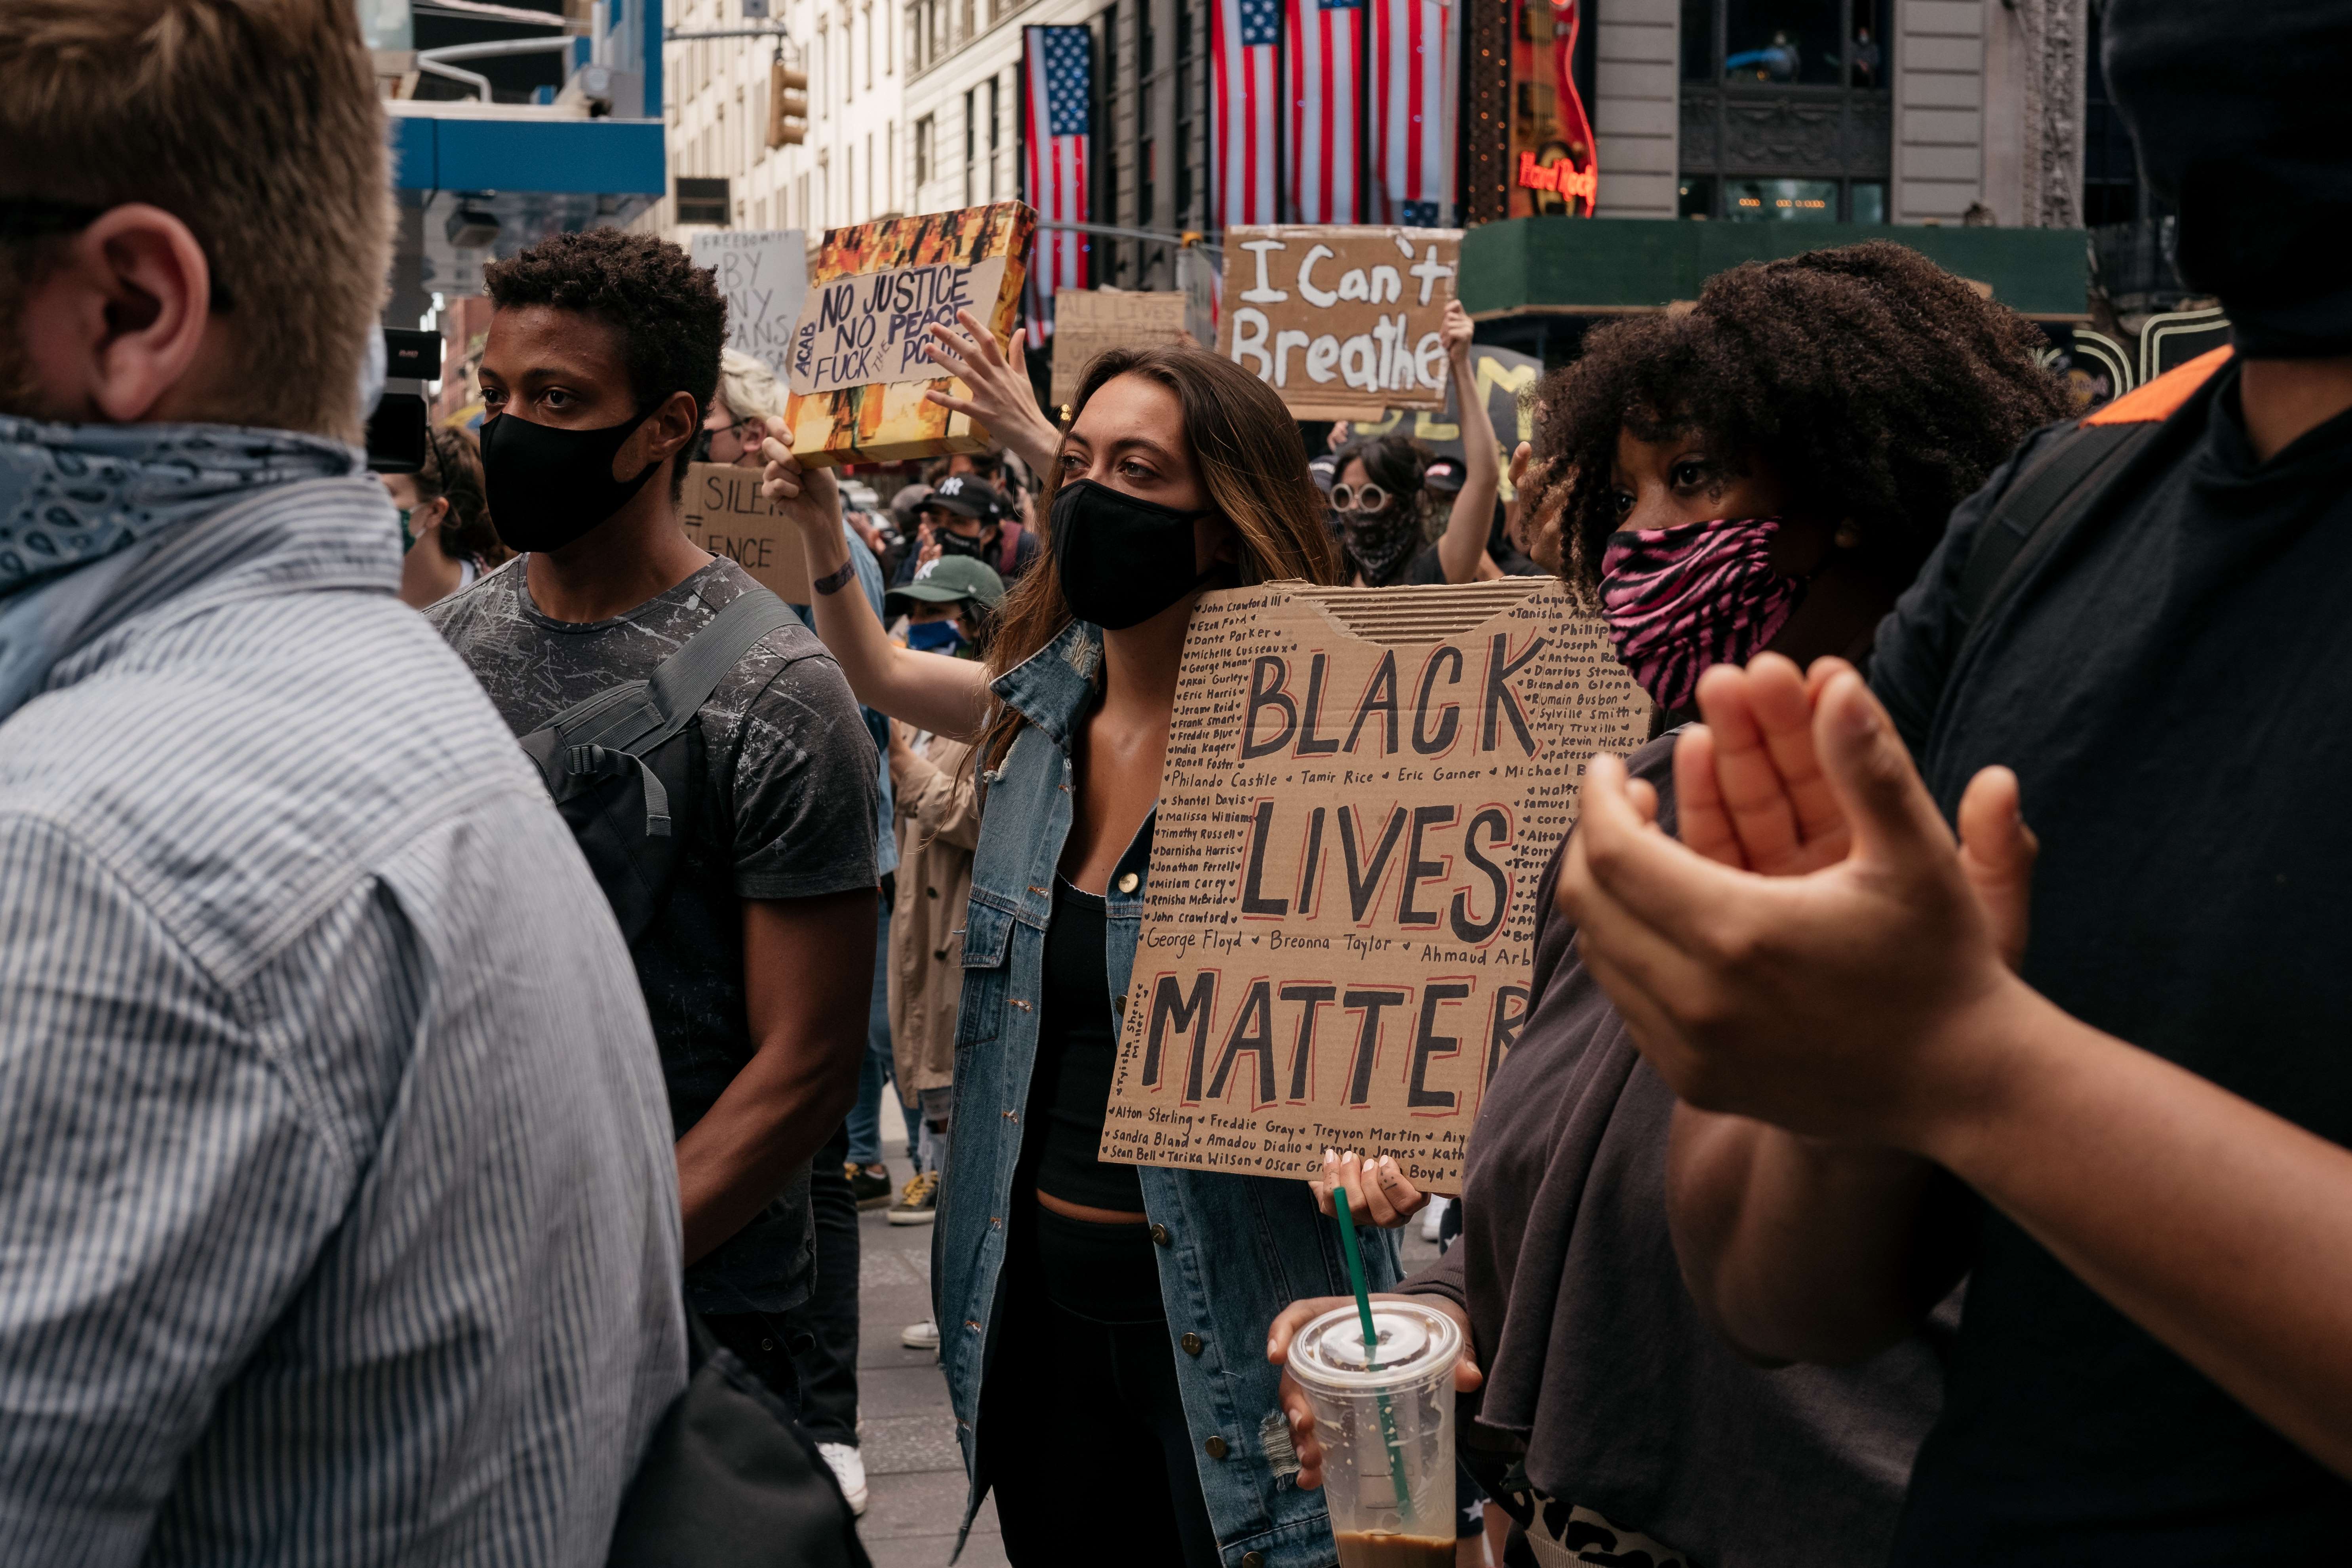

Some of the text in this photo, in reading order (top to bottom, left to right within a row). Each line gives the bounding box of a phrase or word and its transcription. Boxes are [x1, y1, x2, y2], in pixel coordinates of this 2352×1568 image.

[723, 250, 762, 289] BY
[1238, 238, 1288, 304] I
[819, 265, 972, 333] NO JUSTICE
[835, 300, 974, 354] NO PEACE
[795, 321, 816, 377] ACAB
[1232, 306, 1449, 393] Breathe
[813, 346, 873, 389] FUCK
[872, 339, 891, 372] THE
[1202, 603, 1223, 613] John
[1227, 596, 1267, 613] Crawford
[1516, 607, 1563, 619] Tanisha
[1222, 614, 1246, 629] Ford
[1560, 623, 1608, 639] Phillip
[1194, 634, 1225, 645] Dante
[1556, 639, 1597, 653] Joseph
[1191, 645, 1288, 659] Michelle Cusseaux
[1548, 653, 1594, 663] Antwon
[1189, 662, 1219, 675] George
[1534, 665, 1581, 678] Darrius
[1212, 674, 1242, 685] Gurley
[1527, 679, 1631, 690] Brendon Glenn
[1183, 687, 1236, 700] Eric Harris
[1241, 633, 1547, 759] BLACK
[1532, 693, 1572, 706] Rumain
[1214, 700, 1234, 713] Reid
[1539, 708, 1582, 721] Sylville
[1178, 718, 1203, 728] Frank
[1536, 722, 1616, 736] Mary Truxillo
[1178, 729, 1233, 740] Freddie Blue
[1561, 735, 1591, 747] Kevin
[1174, 743, 1230, 758] India Kager
[1175, 757, 1233, 769] Ronell Foster
[1171, 770, 1223, 787] Philando
[1231, 772, 1277, 788] Castile
[1301, 770, 1336, 784] Tamir
[1344, 770, 1373, 785] Rice
[1398, 767, 1423, 782] Eric
[1433, 767, 1480, 781] Garner
[1505, 764, 1568, 778] Michael
[1171, 793, 1246, 806] Shantel Davis
[1166, 811, 1254, 823] Malissa Williams
[1161, 827, 1235, 841] Timothy Russell
[1160, 844, 1235, 856] Darnisha Harris
[1155, 860, 1235, 873] Jonathan Ferrell
[1241, 802, 1507, 943] LIVES
[1155, 877, 1190, 889] Miriam
[1151, 893, 1228, 906] Renisha McBride
[1151, 911, 1174, 923] John
[1147, 927, 1195, 959] George
[1203, 929, 1242, 955] Floyd
[1270, 929, 1330, 950] Breonna
[1343, 934, 1391, 960] Taylor
[1421, 944, 1486, 965] Ahmaud
[1132, 1012, 1144, 1058] Miller
[1142, 972, 1531, 1107] MATTER
[1117, 1041, 1132, 1086] Tyisha
[1115, 1105, 1468, 1149] Alton Sterling Freddie Gray Treyvon Martin Aiy
[1113, 1129, 1148, 1145] Sandra
[1154, 1132, 1189, 1148] Bland
[1207, 1134, 1256, 1151] Amadou
[1264, 1139, 1302, 1153] Diallo
[1433, 1147, 1464, 1160] Kath
[1110, 1147, 1133, 1159] Sean
[1136, 1147, 1156, 1161] Bell
[1167, 1150, 1203, 1164] Tarika
[1208, 1151, 1251, 1166] Wilson
[1265, 1158, 1301, 1172] Oscar
[1306, 1160, 1324, 1173] Gr
[1410, 1164, 1444, 1183] Boyd
